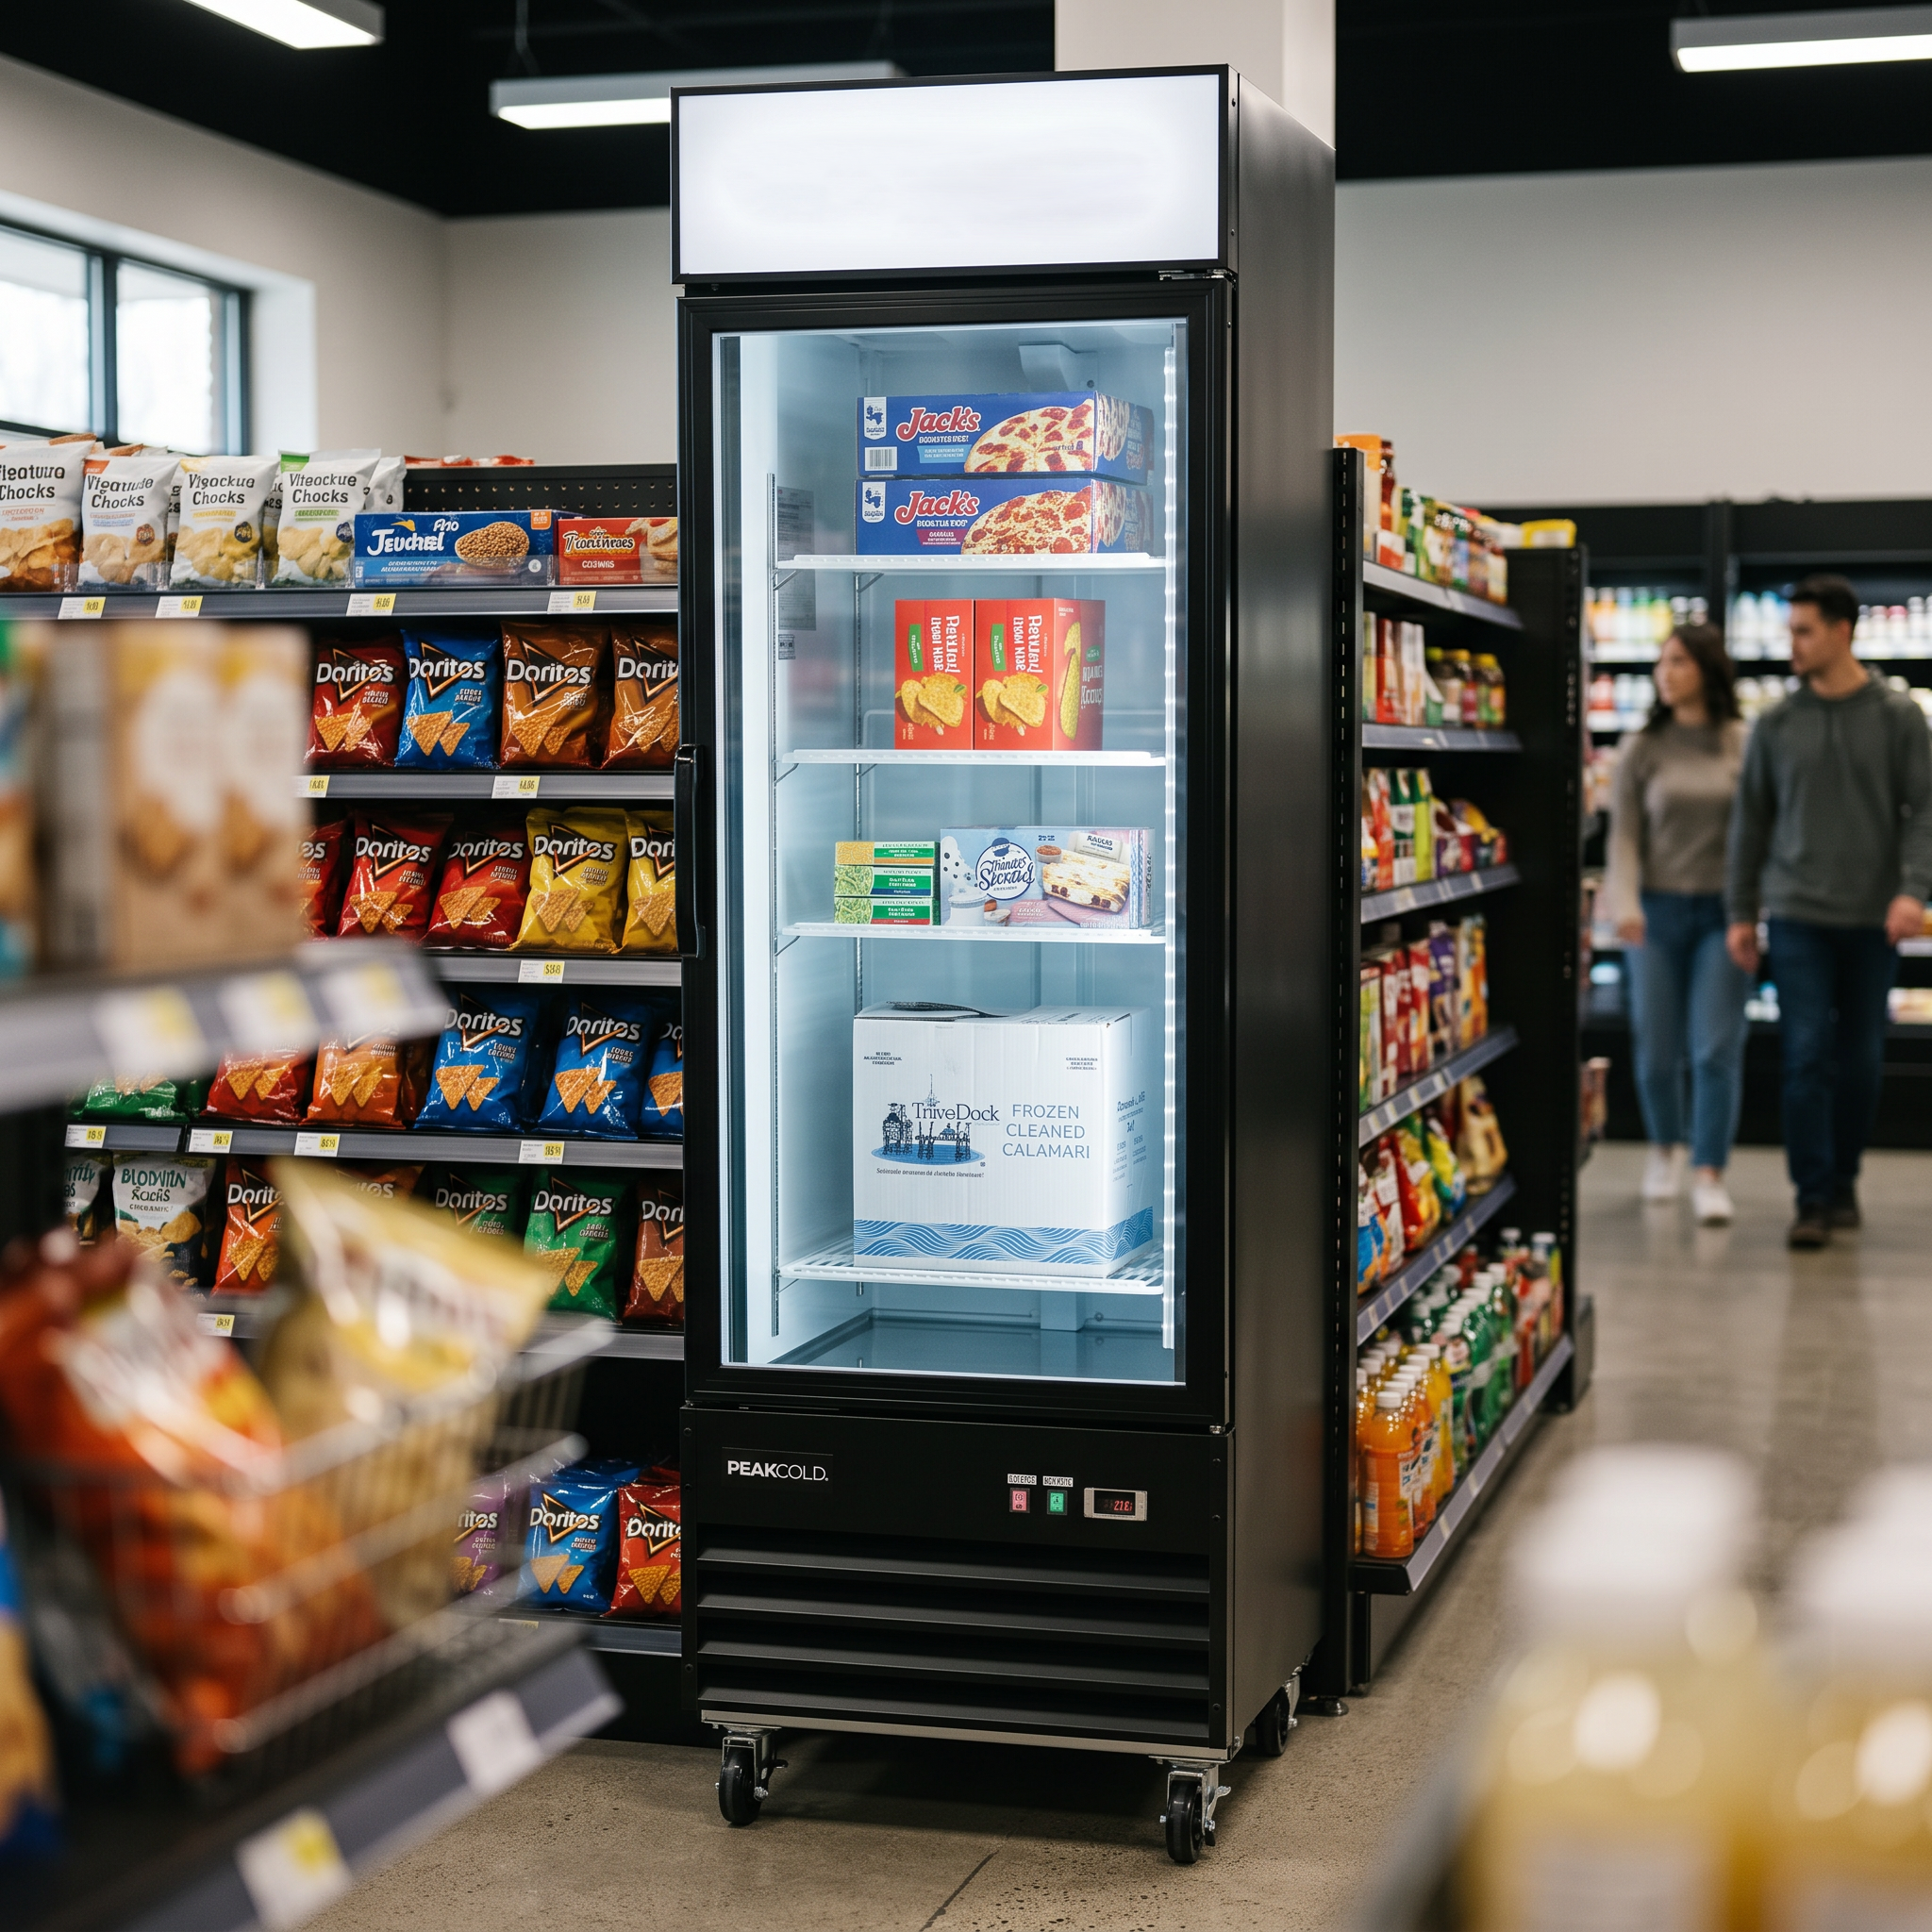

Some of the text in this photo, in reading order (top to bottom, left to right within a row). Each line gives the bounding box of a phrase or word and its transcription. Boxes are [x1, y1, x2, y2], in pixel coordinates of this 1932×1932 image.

[896, 406, 981, 441] Jack's
[92, 493, 145, 508] Chocks
[192, 491, 245, 505] Chocks
[292, 489, 349, 504] Chocks
[894, 490, 980, 525] Jack's
[316, 662, 394, 684] Doritos
[409, 658, 486, 680] Doritos
[507, 659, 591, 684] Doritos
[618, 657, 679, 679] Dorit
[356, 837, 432, 863] Doritos
[448, 838, 525, 860] Doritos
[535, 836, 615, 860] Doritos
[444, 1008, 523, 1037] Doritos
[567, 1015, 641, 1041] Doritos
[1012, 1104, 1079, 1119] FROZEN
[1006, 1124, 1085, 1139] CLEANED
[1002, 1142, 1090, 1158] CALAMARI
[435, 1188, 508, 1212] Doritos
[533, 1190, 612, 1215] Doritos
[458, 1509, 499, 1529] ritos
[530, 1507, 600, 1530] Doritos
